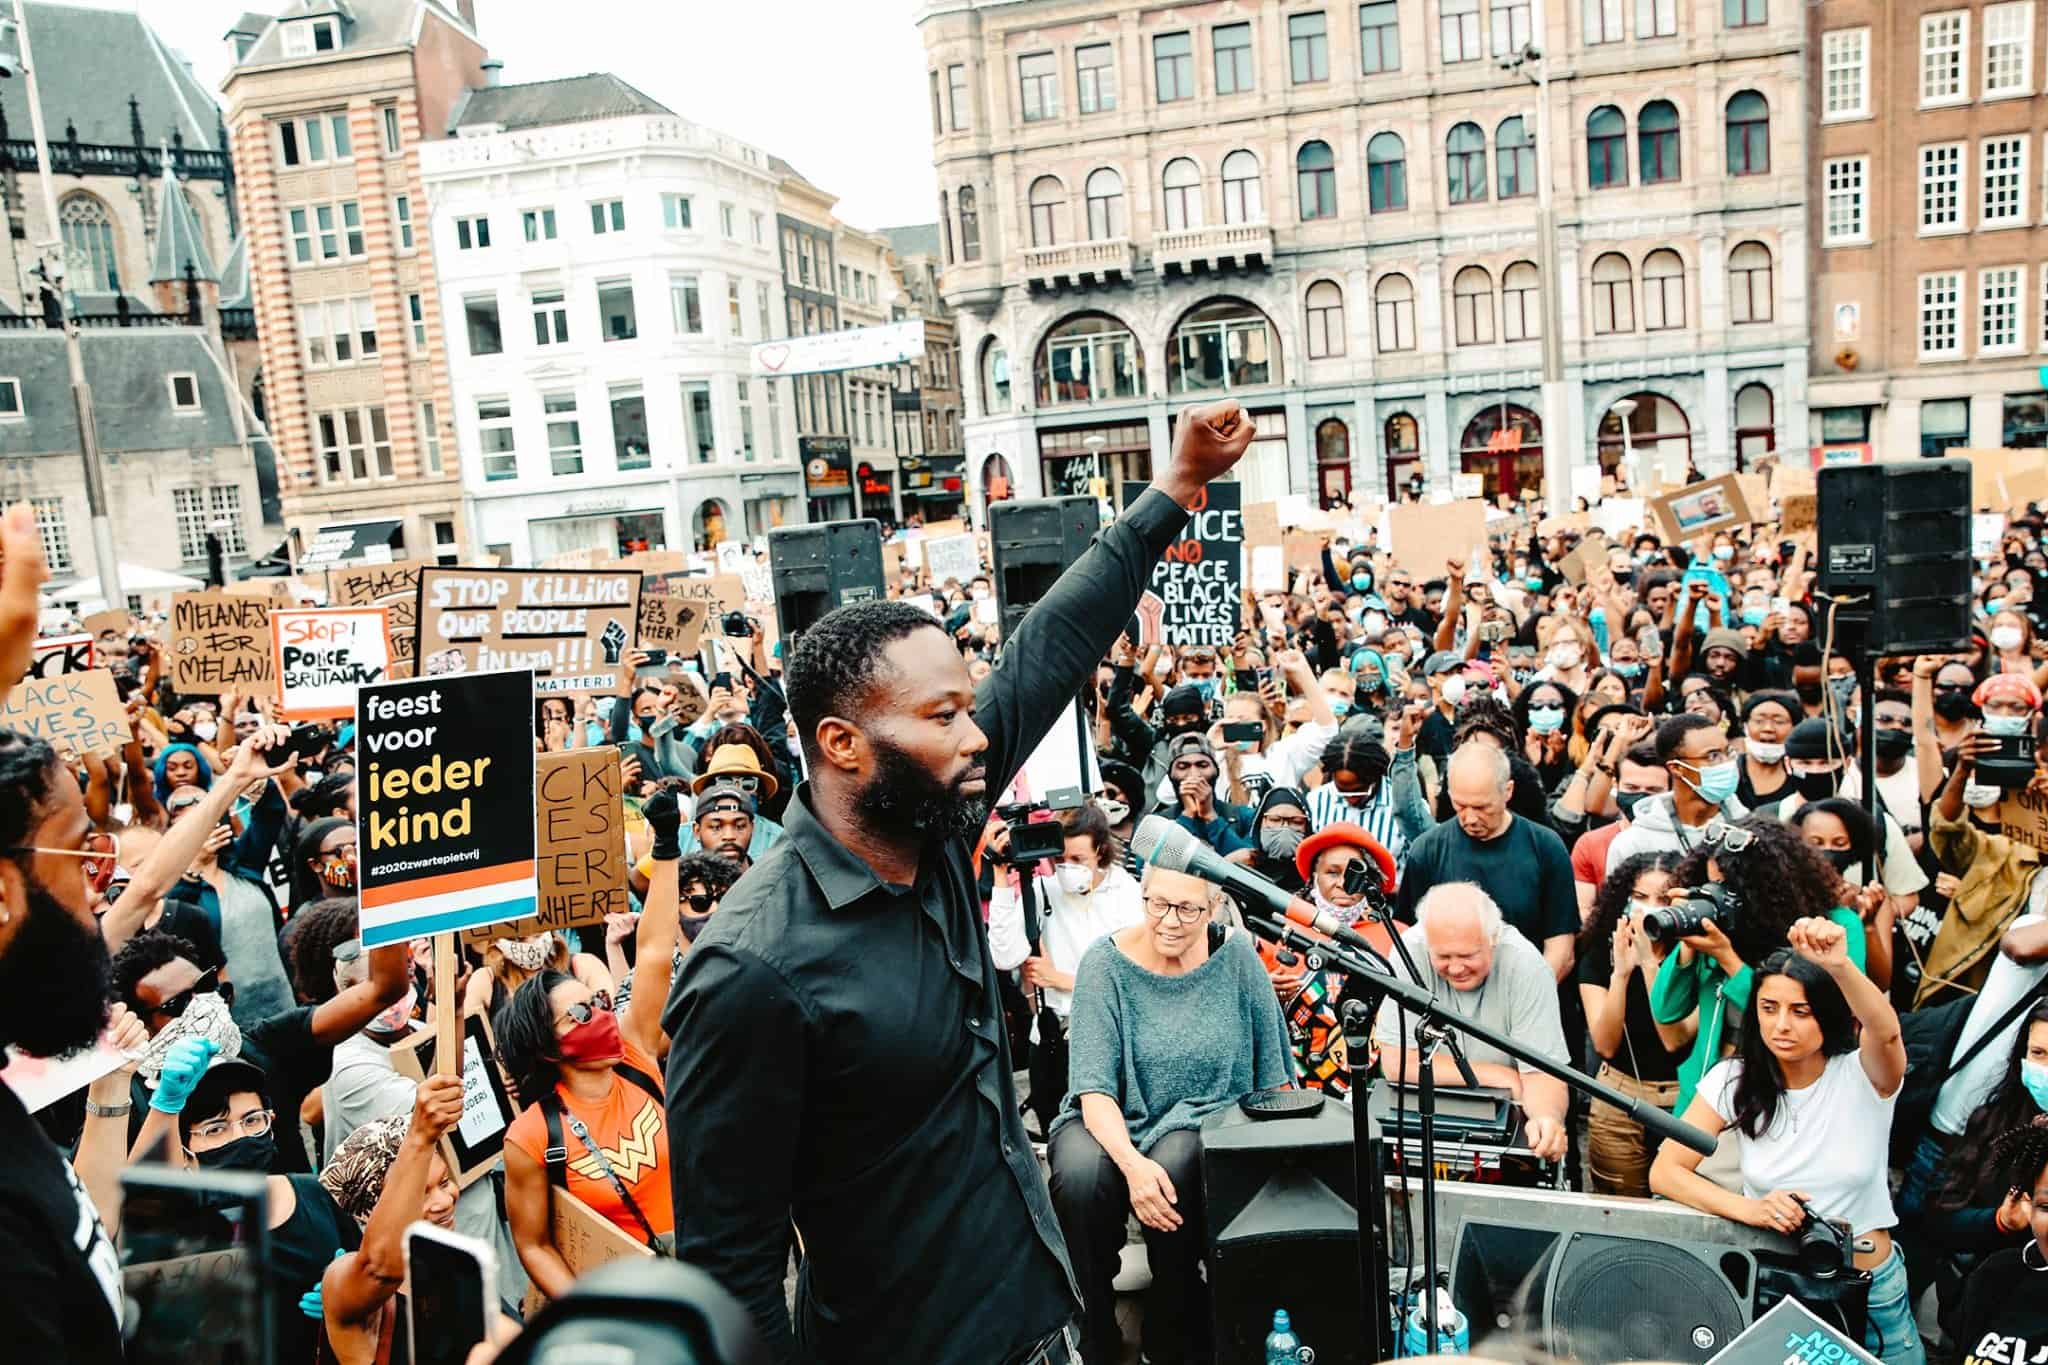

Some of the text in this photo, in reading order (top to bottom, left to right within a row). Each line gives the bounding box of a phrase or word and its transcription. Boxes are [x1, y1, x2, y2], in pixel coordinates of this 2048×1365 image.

[1165, 539, 1203, 564] NO
[344, 568, 419, 599] BLACK
[1152, 560, 1229, 587] PEACE
[429, 577, 509, 608] STOP
[1163, 581, 1241, 604] BLACK
[501, 609, 588, 635] PEOPLE
[1170, 602, 1233, 624] LIVES
[203, 632, 262, 653] FOR
[1161, 623, 1234, 646] MATTER
[367, 690, 442, 722] feest
[367, 725, 437, 753] voor
[368, 753, 491, 802] ieder
[369, 797, 471, 850] kind
[370, 848, 480, 877] #2020zwartepietvrij
